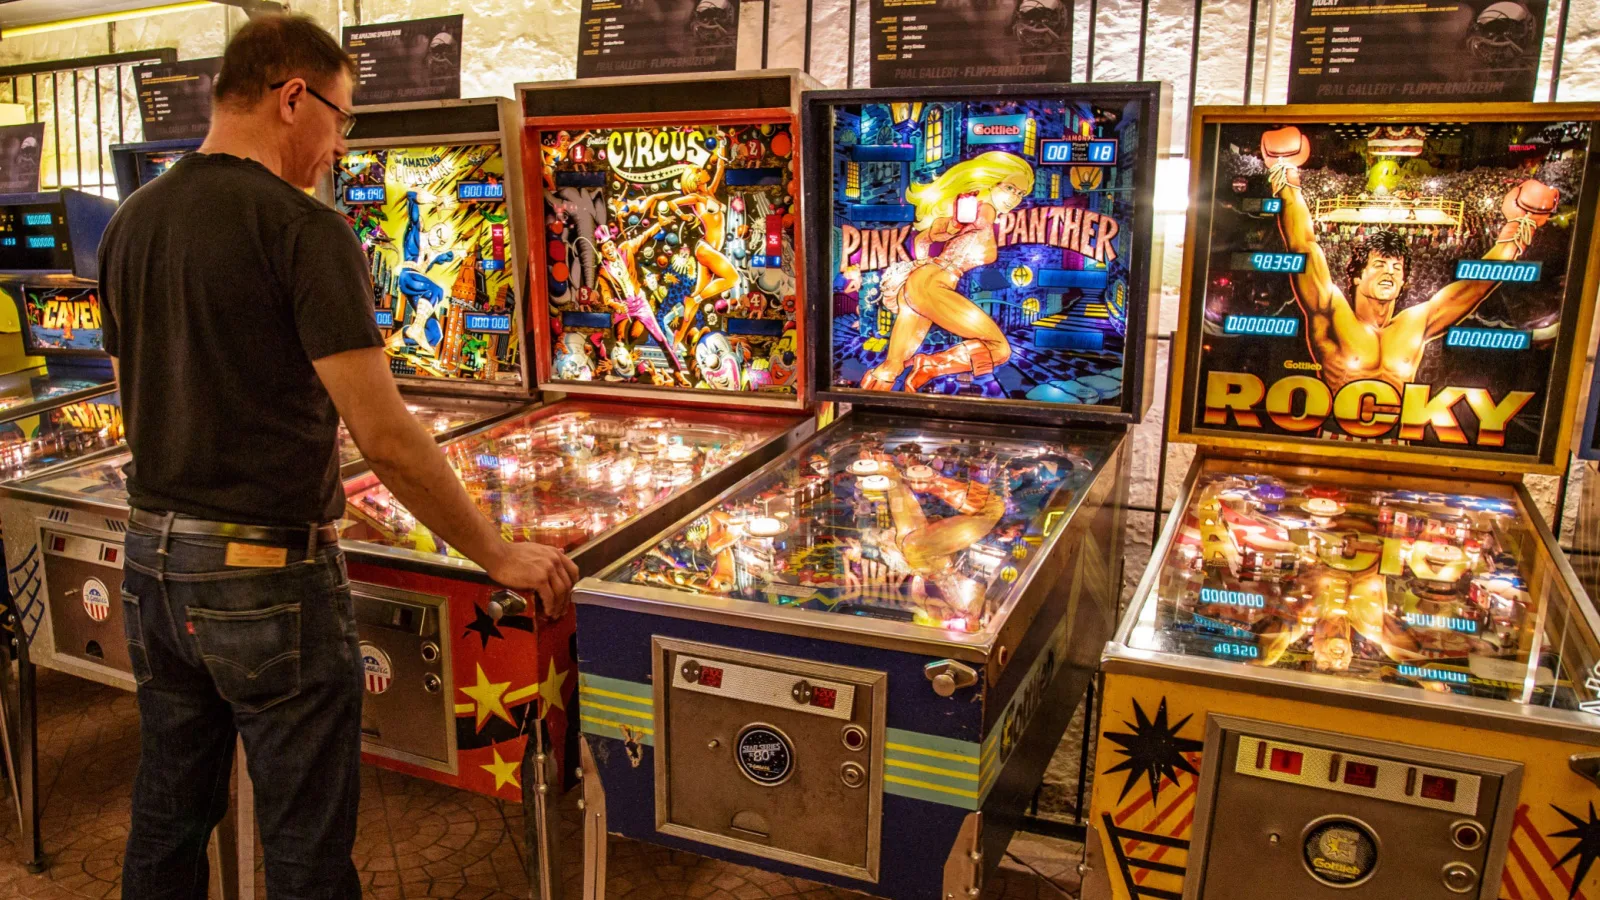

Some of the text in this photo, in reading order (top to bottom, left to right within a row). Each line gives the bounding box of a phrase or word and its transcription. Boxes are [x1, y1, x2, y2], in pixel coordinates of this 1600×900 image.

[919, 67, 958, 78] GALLERY
[1347, 83, 1394, 95] GALLERY
[973, 123, 1020, 135] Gottlieb
[607, 130, 711, 170] CIRCUS
[1047, 145, 1068, 160] 00
[1093, 145, 1112, 160] 18
[402, 154, 441, 168] AMAZING
[1266, 201, 1280, 212] 13
[839, 207, 1120, 272] PINK PANTHER
[1283, 360, 1322, 371] Gottlieb
[1203, 370, 1536, 447] ROCKY
[1312, 857, 1361, 875] Gottlieb
